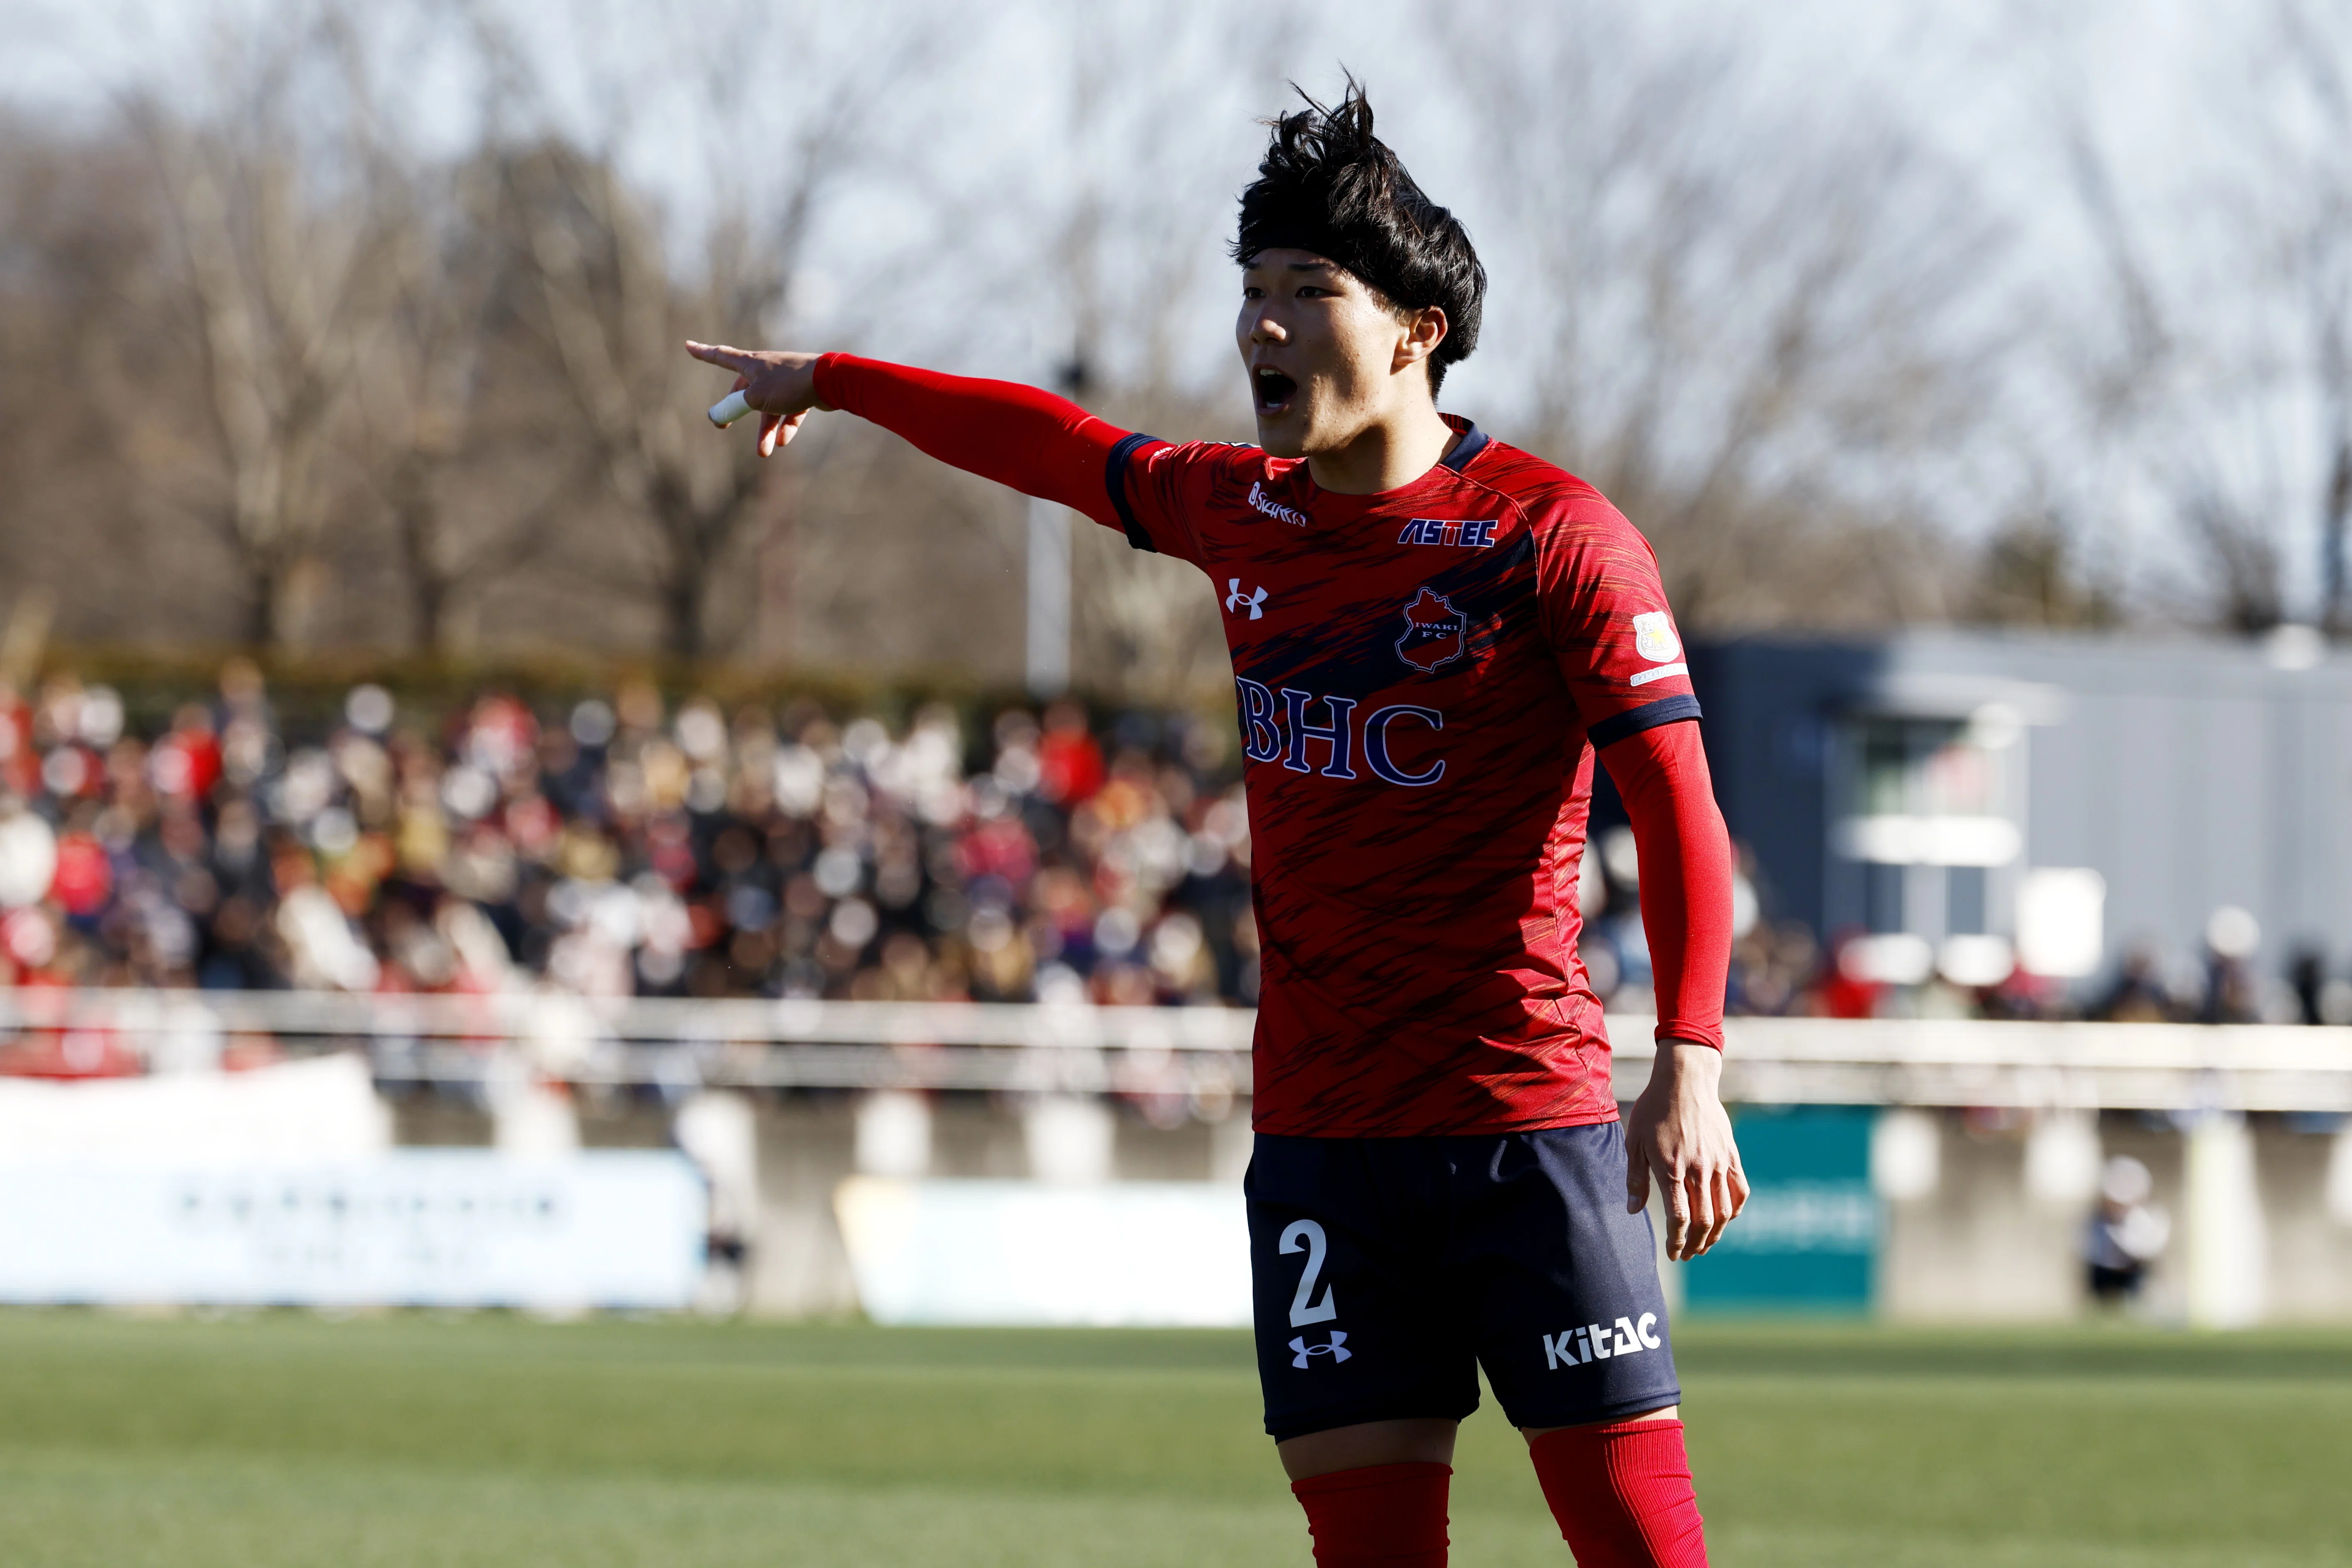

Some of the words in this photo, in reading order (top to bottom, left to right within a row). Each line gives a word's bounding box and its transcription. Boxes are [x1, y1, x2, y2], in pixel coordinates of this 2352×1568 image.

[1398, 518, 1498, 547] ASTEC
[1236, 676, 1445, 786] BHC
[1279, 1219, 1336, 1328] 2
